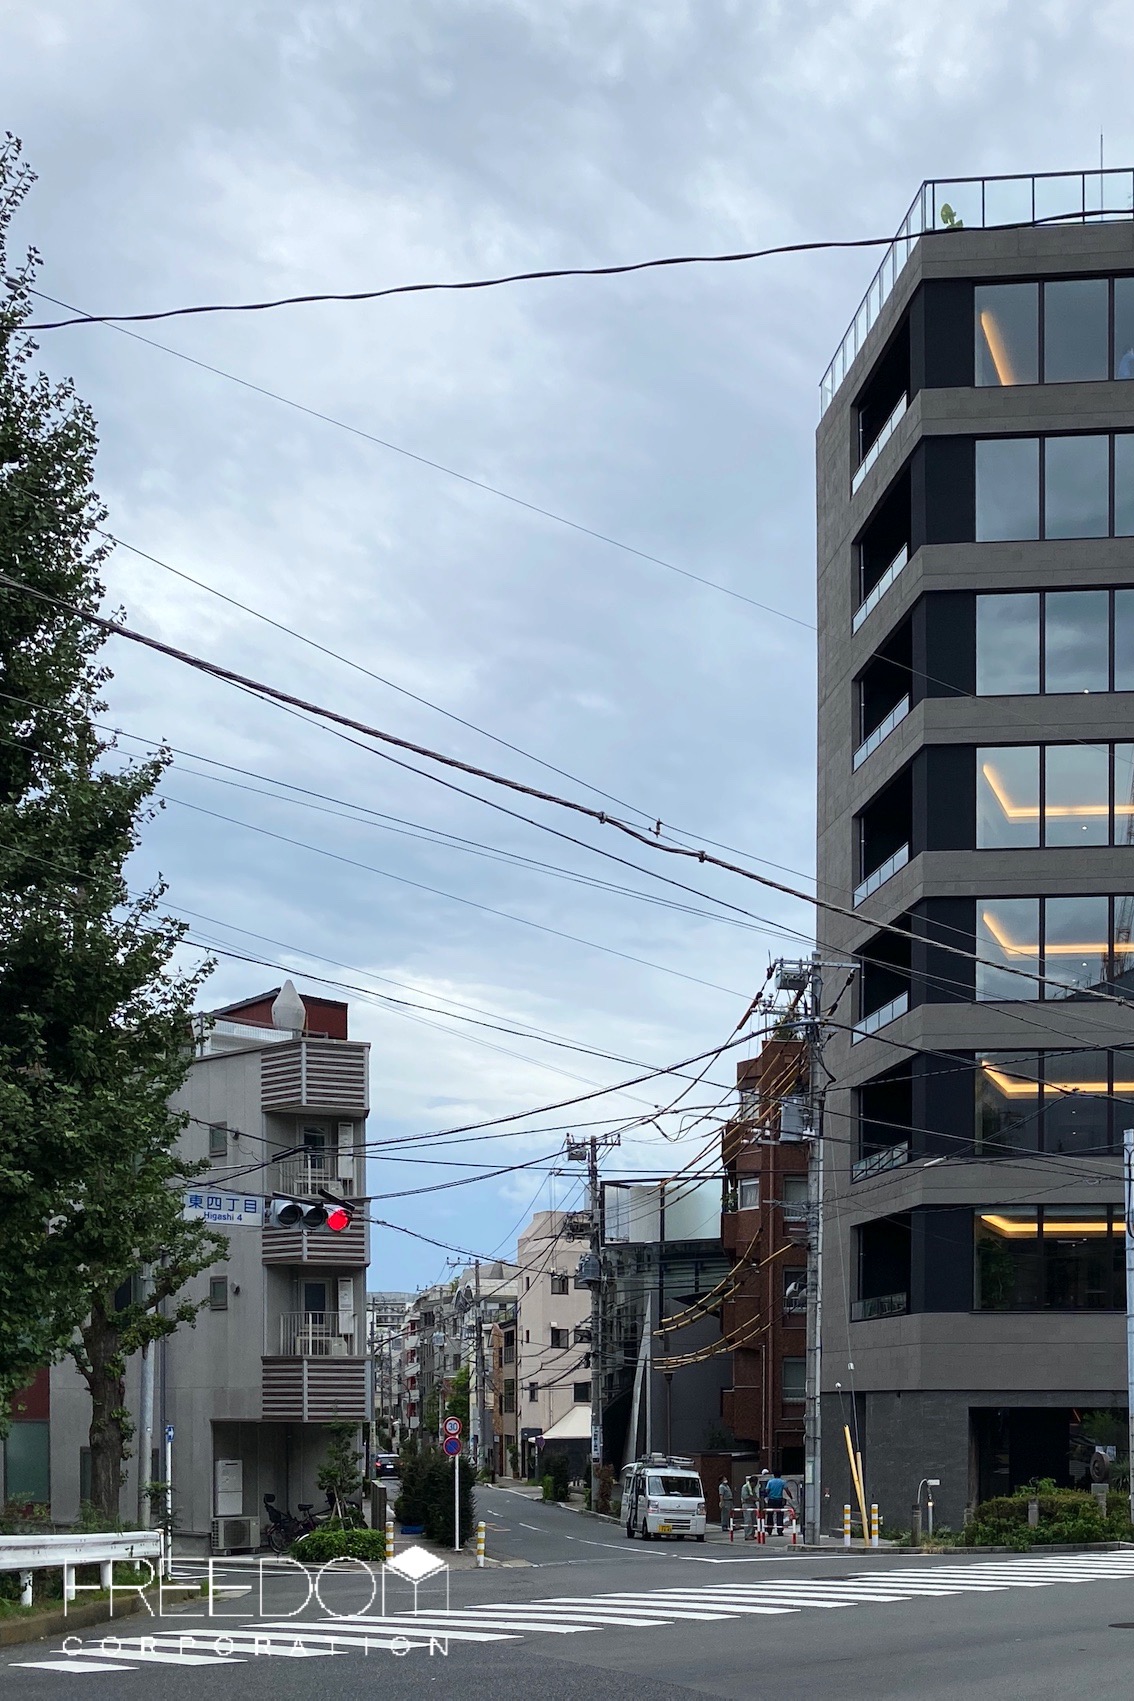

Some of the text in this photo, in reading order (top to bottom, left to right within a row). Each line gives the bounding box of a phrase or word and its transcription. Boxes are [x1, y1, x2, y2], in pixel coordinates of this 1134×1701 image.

[188, 1194, 257, 1214] 東四丁目
[203, 1210, 243, 1221] Higashi 4
[448, 1422, 458, 1431] 30
